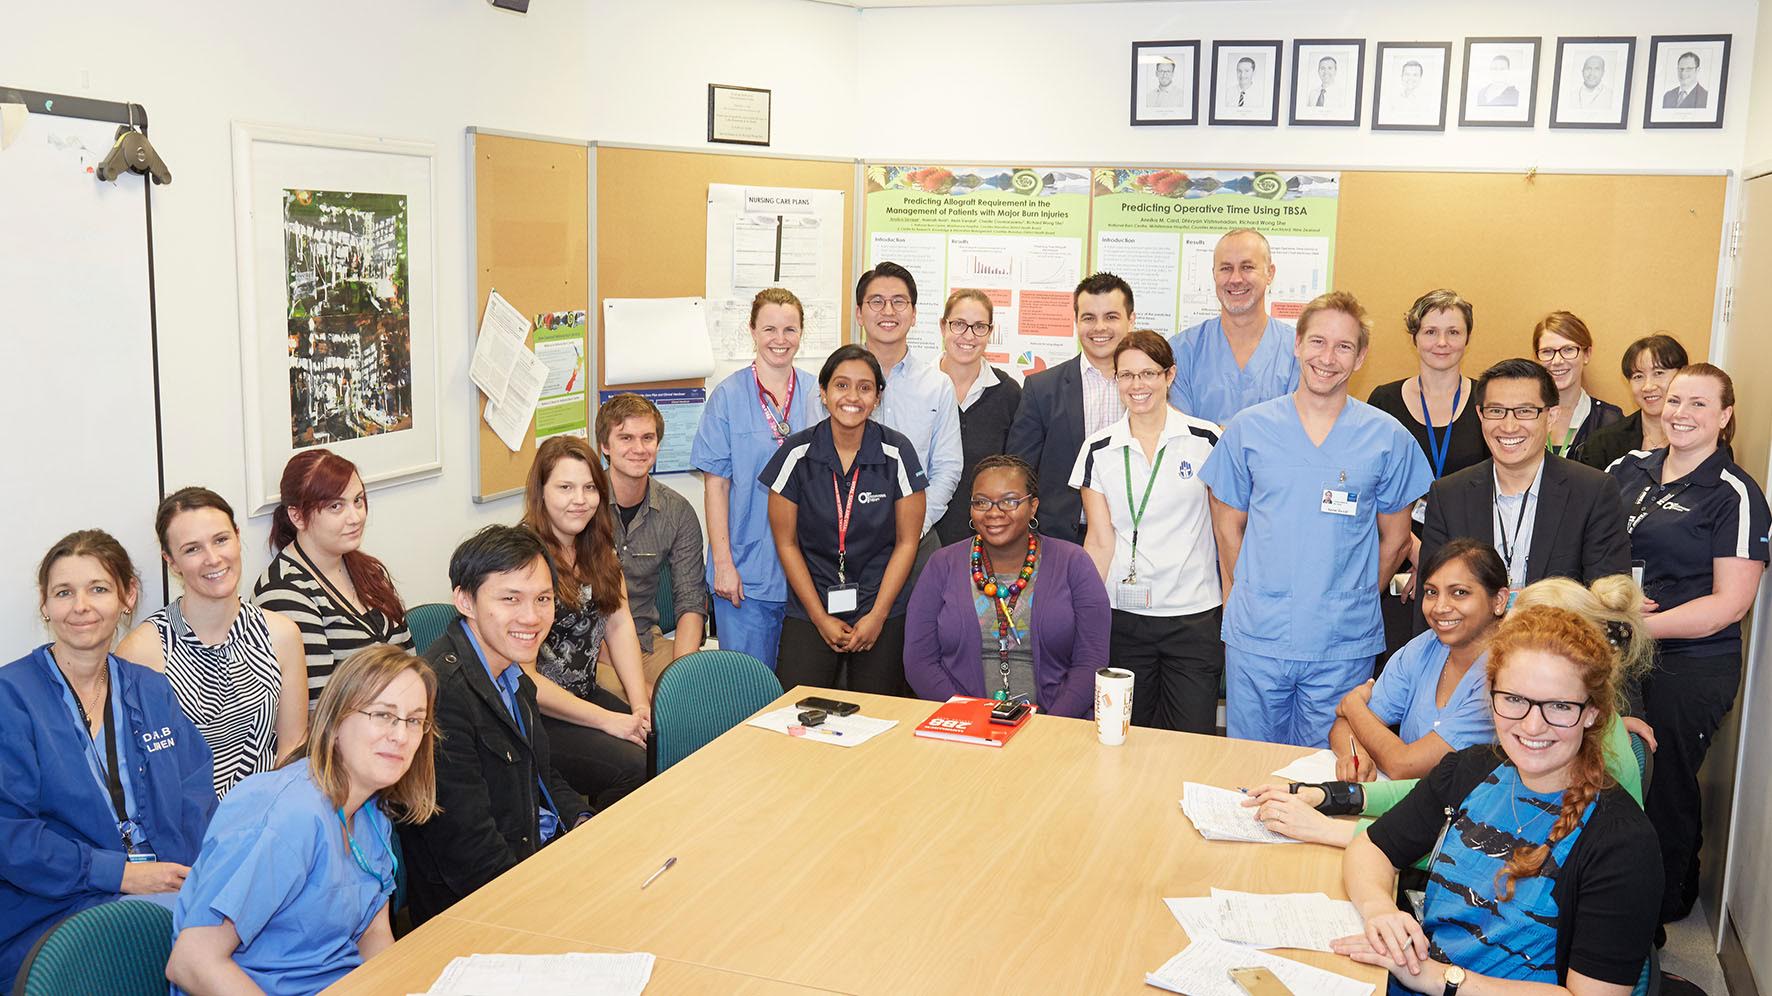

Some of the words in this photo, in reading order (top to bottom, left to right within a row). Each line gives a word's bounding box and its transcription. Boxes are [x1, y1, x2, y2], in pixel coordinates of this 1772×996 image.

[904, 198, 942, 206] Predicting
[944, 198, 976, 207] Allograft
[978, 198, 1026, 208] Requirement
[1122, 202, 1170, 214] Predicting
[1174, 204, 1224, 214] Operative
[1226, 204, 1250, 214] Time
[1254, 206, 1280, 216] Using
[1284, 206, 1308, 215] TBSA
[886, 207, 937, 216] Management
[998, 210, 1020, 218] Major
[1041, 210, 1068, 219] Injuries
